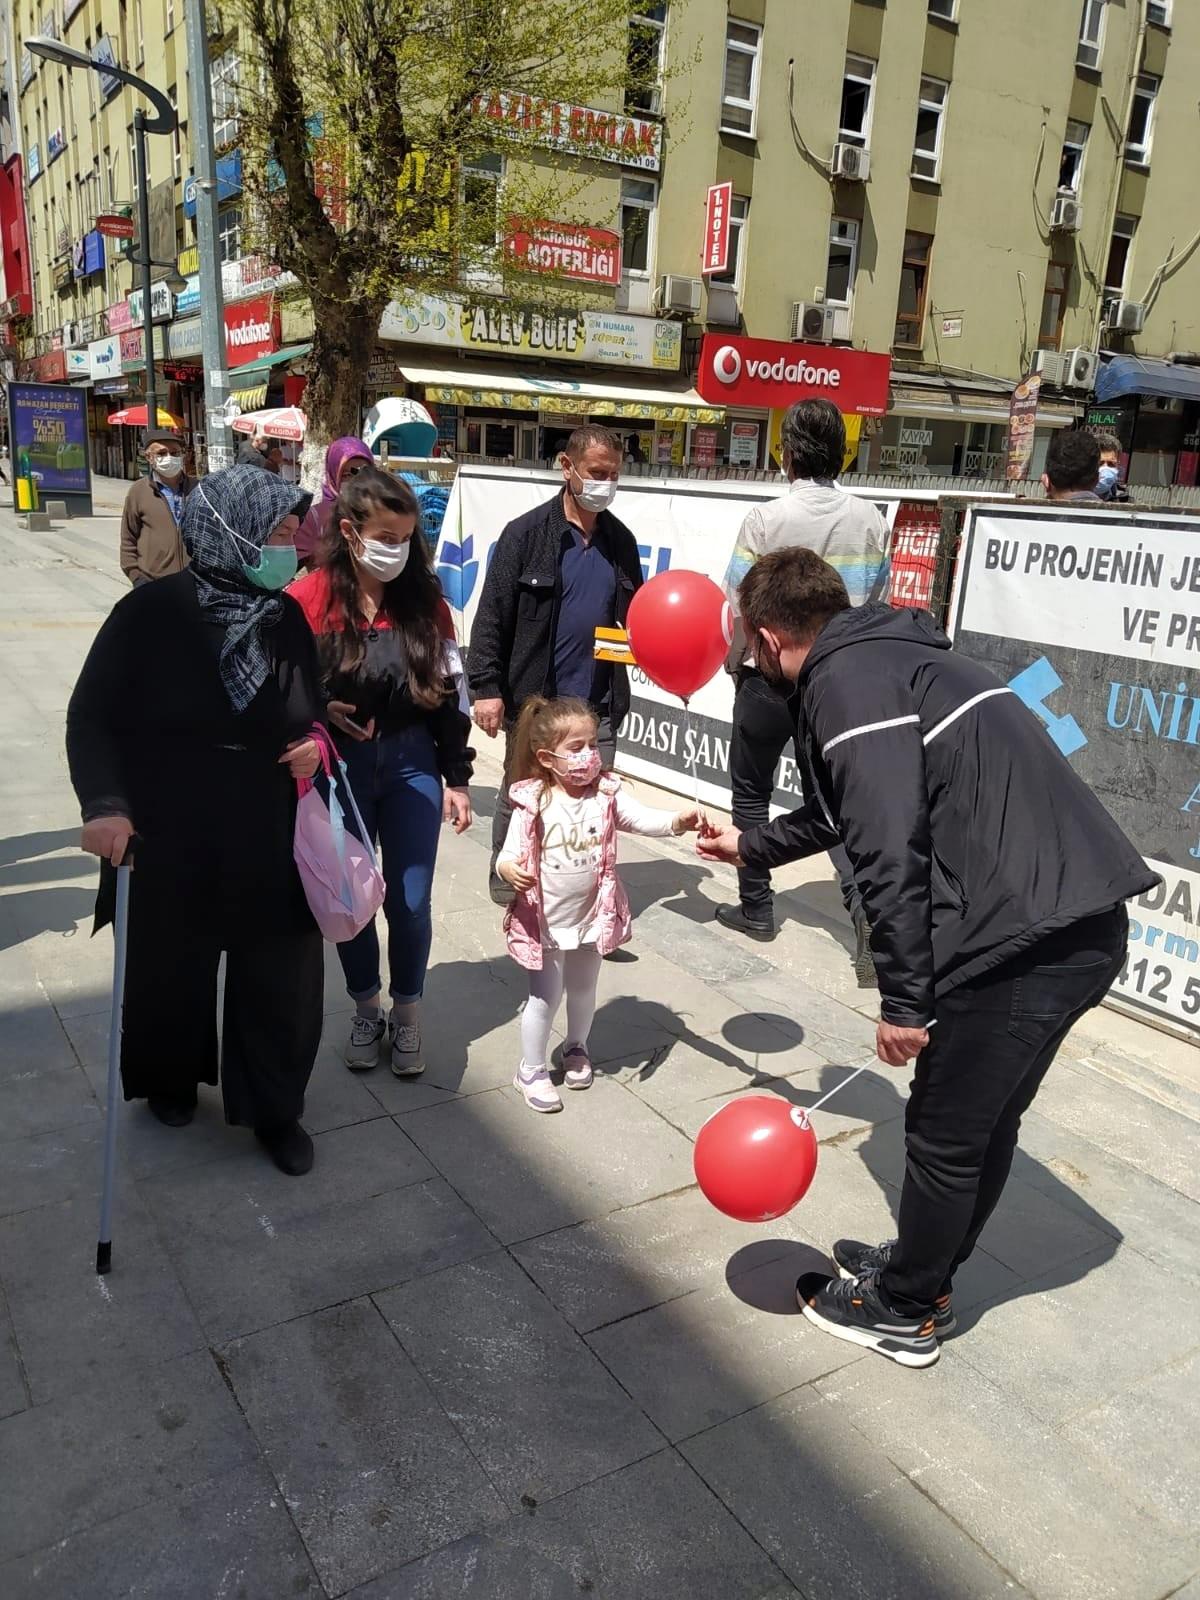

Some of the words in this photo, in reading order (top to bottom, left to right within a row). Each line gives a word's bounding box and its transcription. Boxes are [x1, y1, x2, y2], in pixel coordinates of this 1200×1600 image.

[570, 107, 657, 156] EMLAK
[645, 158, 656, 168] 09
[527, 243, 614, 277] NOTERLİĞİ
[229, 317, 271, 346] vodafone
[470, 305, 525, 345] ALEV
[603, 321, 635, 332] NUMARA
[746, 358, 841, 387] vodafone
[33, 419, 66, 435] %50
[1088, 412, 1117, 424] HİLAL
[270, 427, 295, 436] ALGIDA
[901, 430, 932, 444] KAYRA
[1085, 424, 1116, 436] DÖNER
[985, 538, 1020, 572] BU
[1024, 542, 1164, 588] PROJENİN
[1122, 606, 1160, 645] VE
